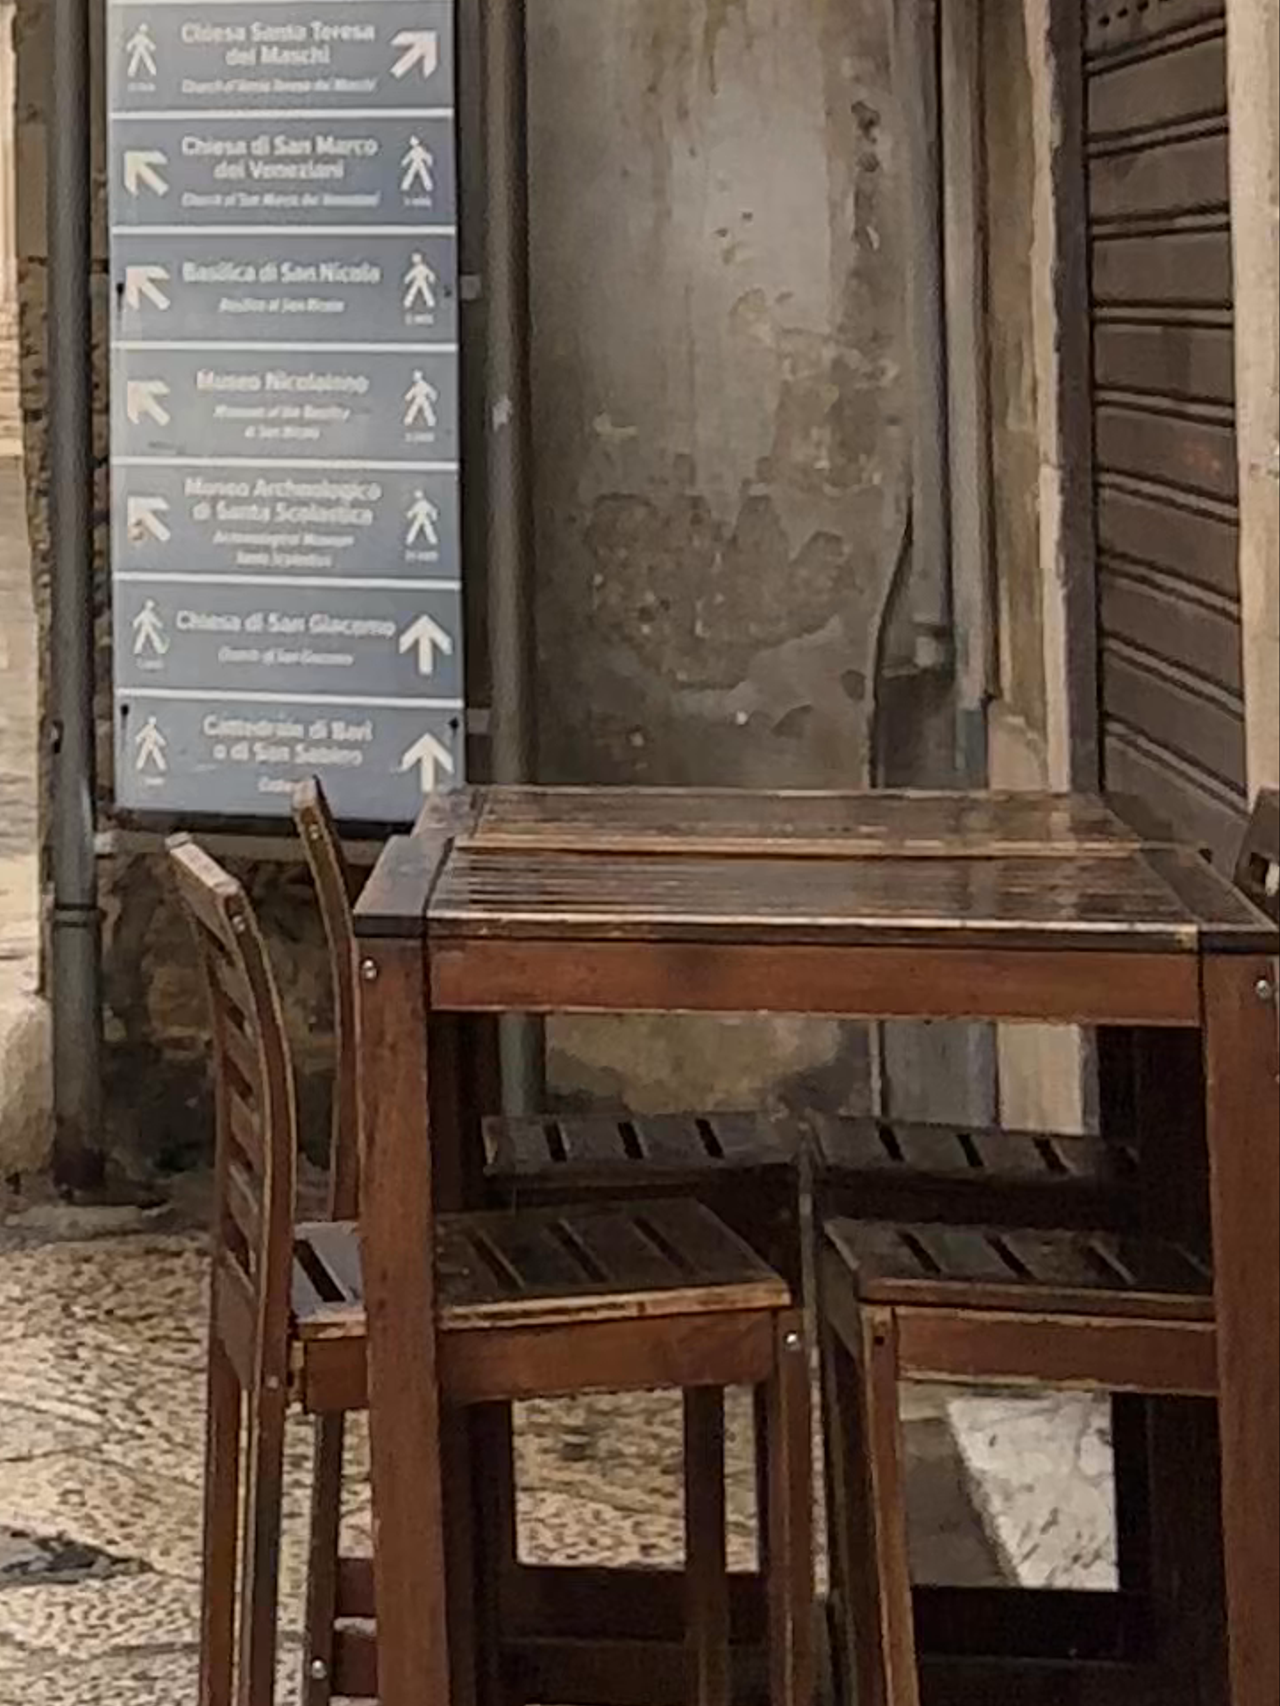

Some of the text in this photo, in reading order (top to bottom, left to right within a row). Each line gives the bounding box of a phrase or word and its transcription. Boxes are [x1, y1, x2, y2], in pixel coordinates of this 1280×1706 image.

[181, 20, 376, 43] Chiesa Santa Teresa
[259, 44, 331, 65] Maschi
[182, 134, 378, 156] Chiesa di San Marco
[213, 159, 345, 179] dei Veneziani
[182, 261, 256, 283] Basilica
[258, 261, 278, 283] di
[280, 261, 317, 283] San
[196, 371, 261, 392] Museo
[175, 609, 241, 631] Chiesa
[267, 611, 306, 633] San
[308, 718, 328, 739] di
[331, 720, 373, 741] Bari
[230, 741, 250, 761] di
